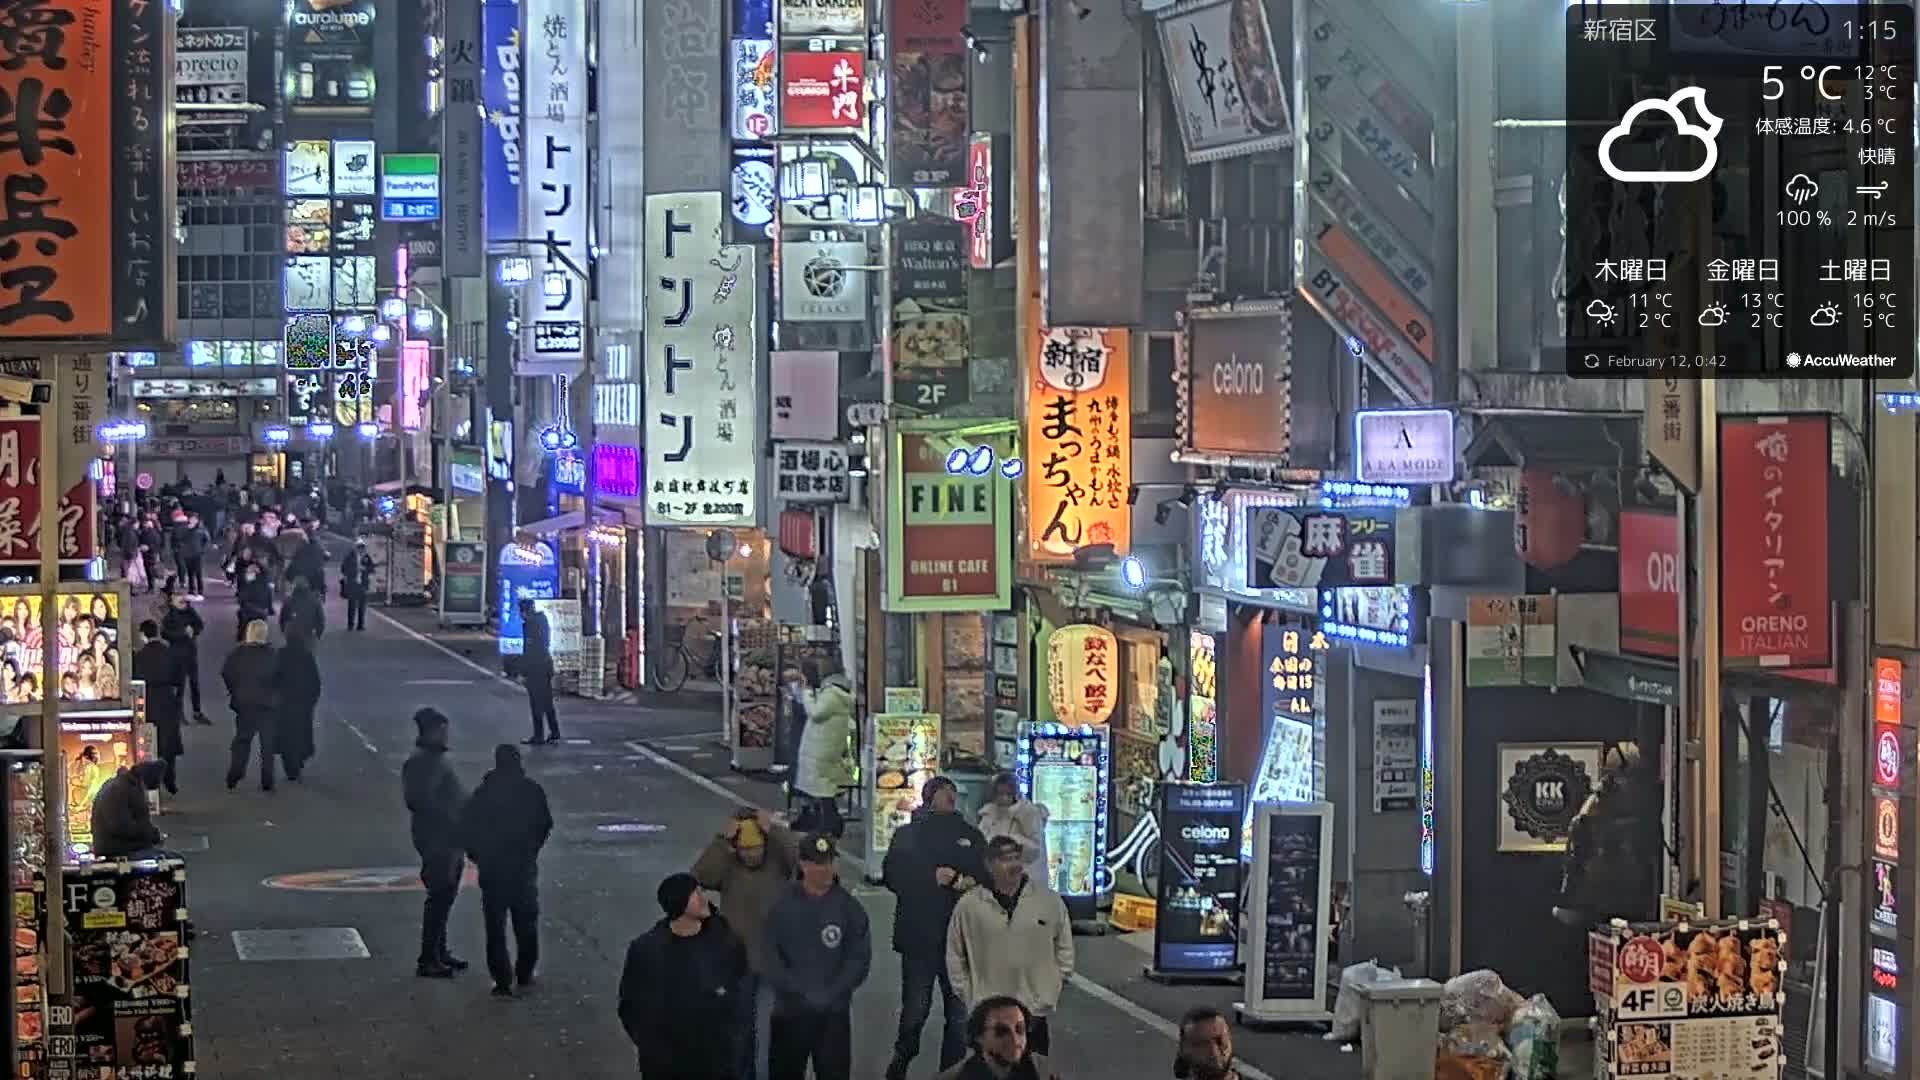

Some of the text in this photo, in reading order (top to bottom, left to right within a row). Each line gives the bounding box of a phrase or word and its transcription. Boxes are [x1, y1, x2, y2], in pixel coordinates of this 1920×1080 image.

[1314, 24, 1332, 41] 5
[808, 39, 837, 51] 2F
[829, 58, 860, 120] 牛門
[1314, 74, 1332, 91] 4
[1315, 121, 1334, 141] 3
[386, 181, 436, 191] FamilyMart
[1314, 171, 1333, 192] 2
[902, 257, 959, 270] Walton's
[1312, 269, 1340, 298] B1
[660, 208, 694, 463] トントン
[1213, 352, 1263, 395] celona
[72, 353, 93, 444] 通り一番街
[917, 385, 947, 404] 2F
[1394, 421, 1412, 448] A
[779, 450, 844, 472] 酒場心
[1041, 395, 1086, 545] まっちゃん
[779, 474, 843, 492] 新宿本店
[911, 485, 987, 513] FINE
[1351, 519, 1390, 535] フリー
[1754, 431, 1787, 603] 俺のイタリアン
[911, 560, 988, 573] ONLINE CAFE
[1742, 615, 1808, 632] ORENO
[1741, 632, 1808, 649] ITALIAN
[1535, 781, 1564, 799] KK
[1182, 826, 1230, 840] celona
[1621, 989, 1656, 1012] 4F
[1692, 991, 1776, 1014] 炭火焼き鳥
